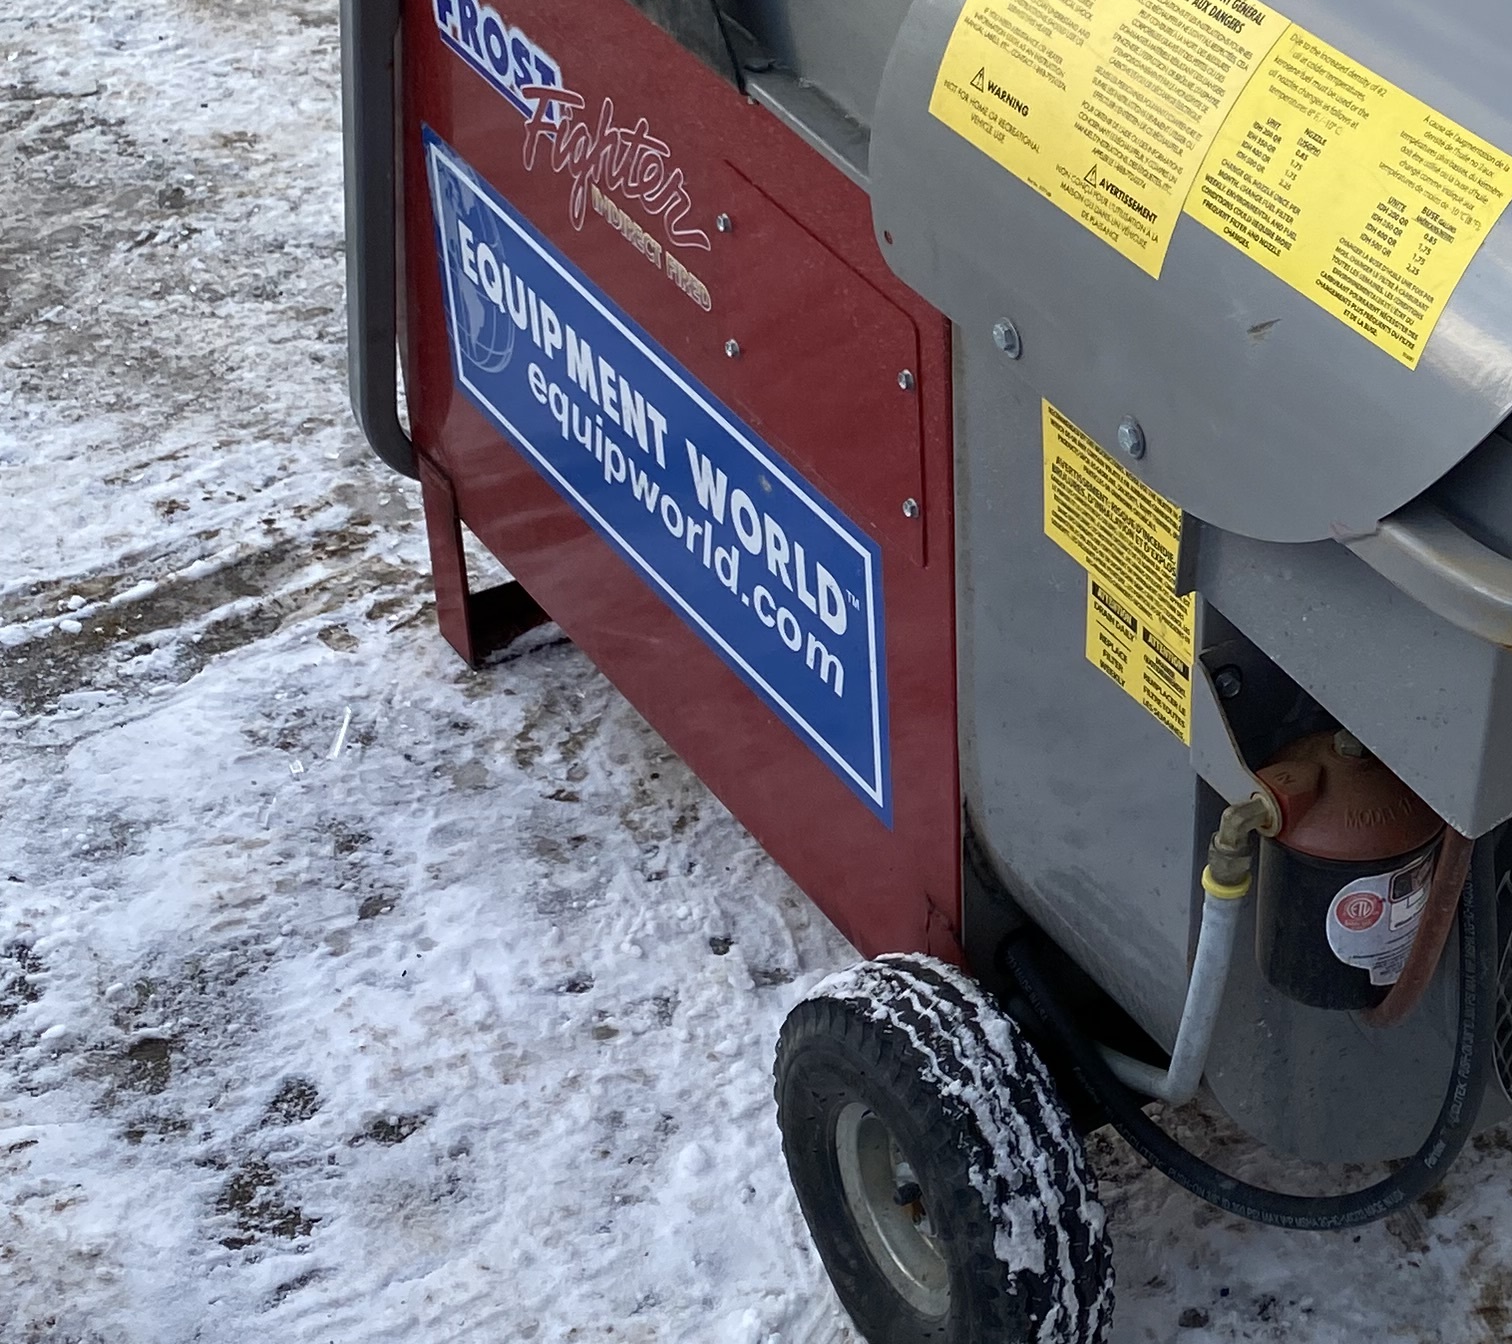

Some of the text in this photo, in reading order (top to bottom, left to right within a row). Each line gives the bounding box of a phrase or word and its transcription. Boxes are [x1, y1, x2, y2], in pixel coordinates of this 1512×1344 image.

[1208, 5, 1245, 34] DANGERS
[1231, 0, 1266, 26] GÉNÉRAL
[1306, 61, 1327, 76] colder
[1319, 52, 1349, 74] increased
[1347, 67, 1370, 88] density
[944, 79, 1040, 154] NOT FOR HOME OR RECREATIONAL
[987, 80, 1029, 117] WARNING
[1311, 80, 1328, 93] must
[1326, 88, 1337, 99] be
[1335, 95, 1353, 108] used
[1357, 108, 1370, 120] the
[971, 113, 994, 135] VEHICLE
[521, 86, 712, 251] Fighter
[1099, 178, 1157, 224] AVERTISSEMENT
[1421, 206, 1440, 222] BUSE
[592, 184, 712, 312] INDIRECT FIRED
[458, 221, 668, 469] EQUIPMENT
[686, 438, 848, 636] WORLD
[528, 361, 846, 699] equipworld.com
[1094, 601, 1135, 642] DRAIN DAILY
[1097, 588, 1131, 626] ATTENTION
[1099, 632, 1127, 664] REPLACE
[1103, 649, 1123, 674] FILTER
[1100, 659, 1125, 687] WEEKLY
[1143, 672, 1177, 709] REMPLACER
[1162, 702, 1185, 729] TOUTES
